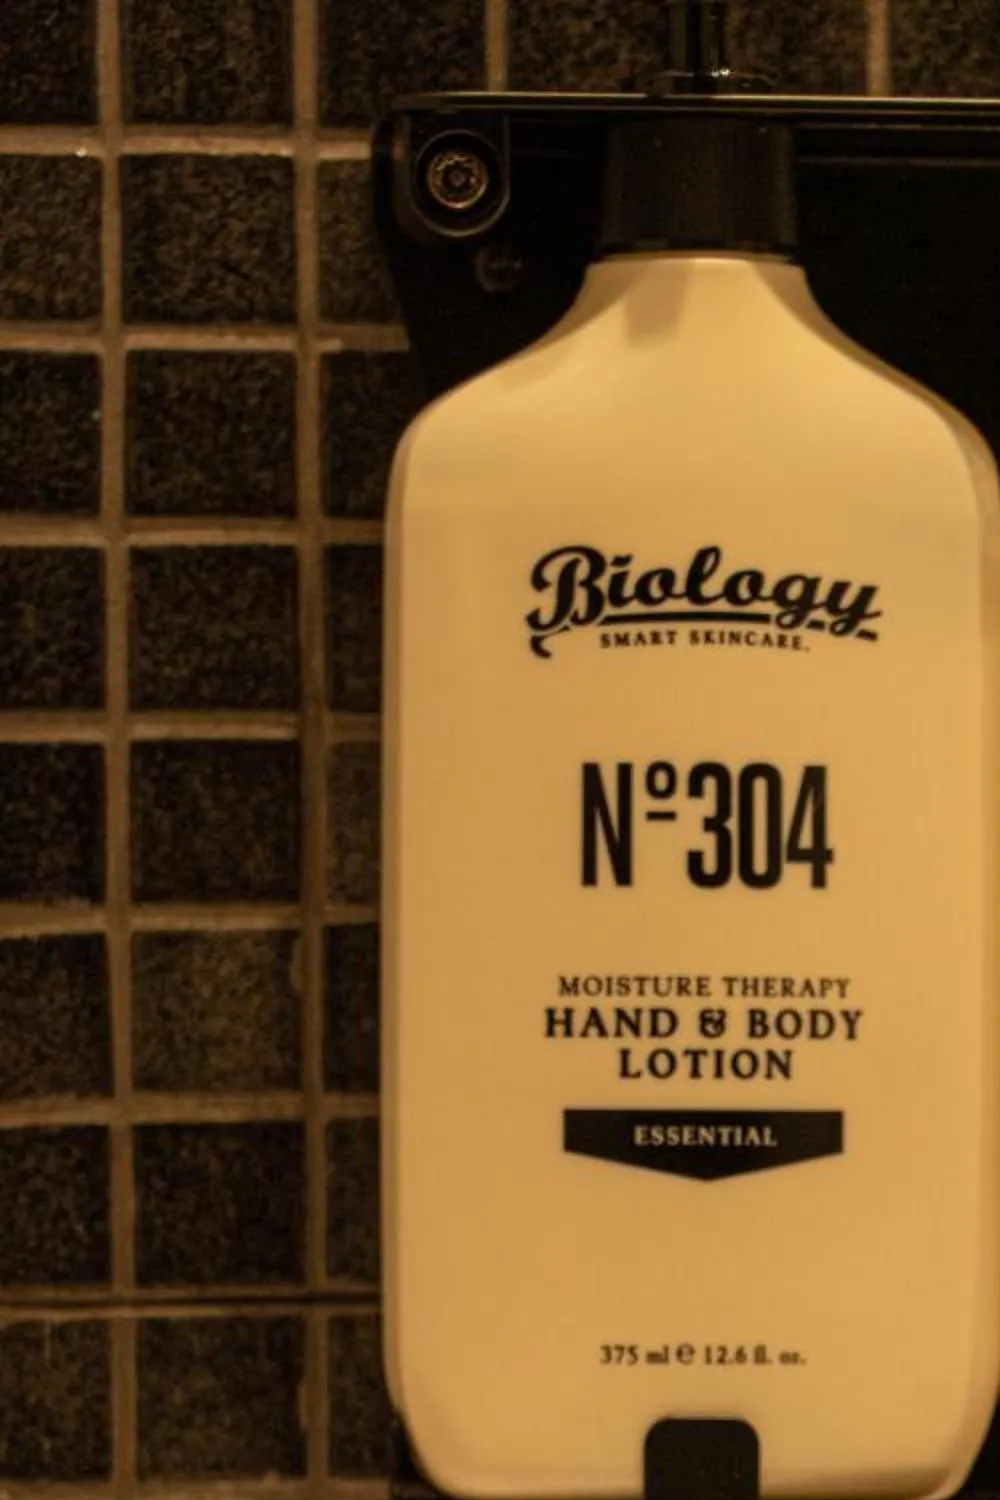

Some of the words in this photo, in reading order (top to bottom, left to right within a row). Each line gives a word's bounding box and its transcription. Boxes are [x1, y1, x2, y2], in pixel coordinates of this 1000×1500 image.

[525, 545, 883, 658] Biology
[600, 629, 678, 649] SMART
[558, 976, 711, 997] MOISTURE
[722, 976, 852, 999] THERAPY
[545, 1007, 679, 1039] HAND
[699, 1009, 727, 1038] &
[747, 1009, 863, 1040] BODY
[619, 1047, 794, 1080] LOTION
[634, 1125, 778, 1147] ESSENTIAL
[600, 1344, 639, 1366] 375
[645, 1345, 670, 1365] ml
[704, 1345, 747, 1366] 12.6
